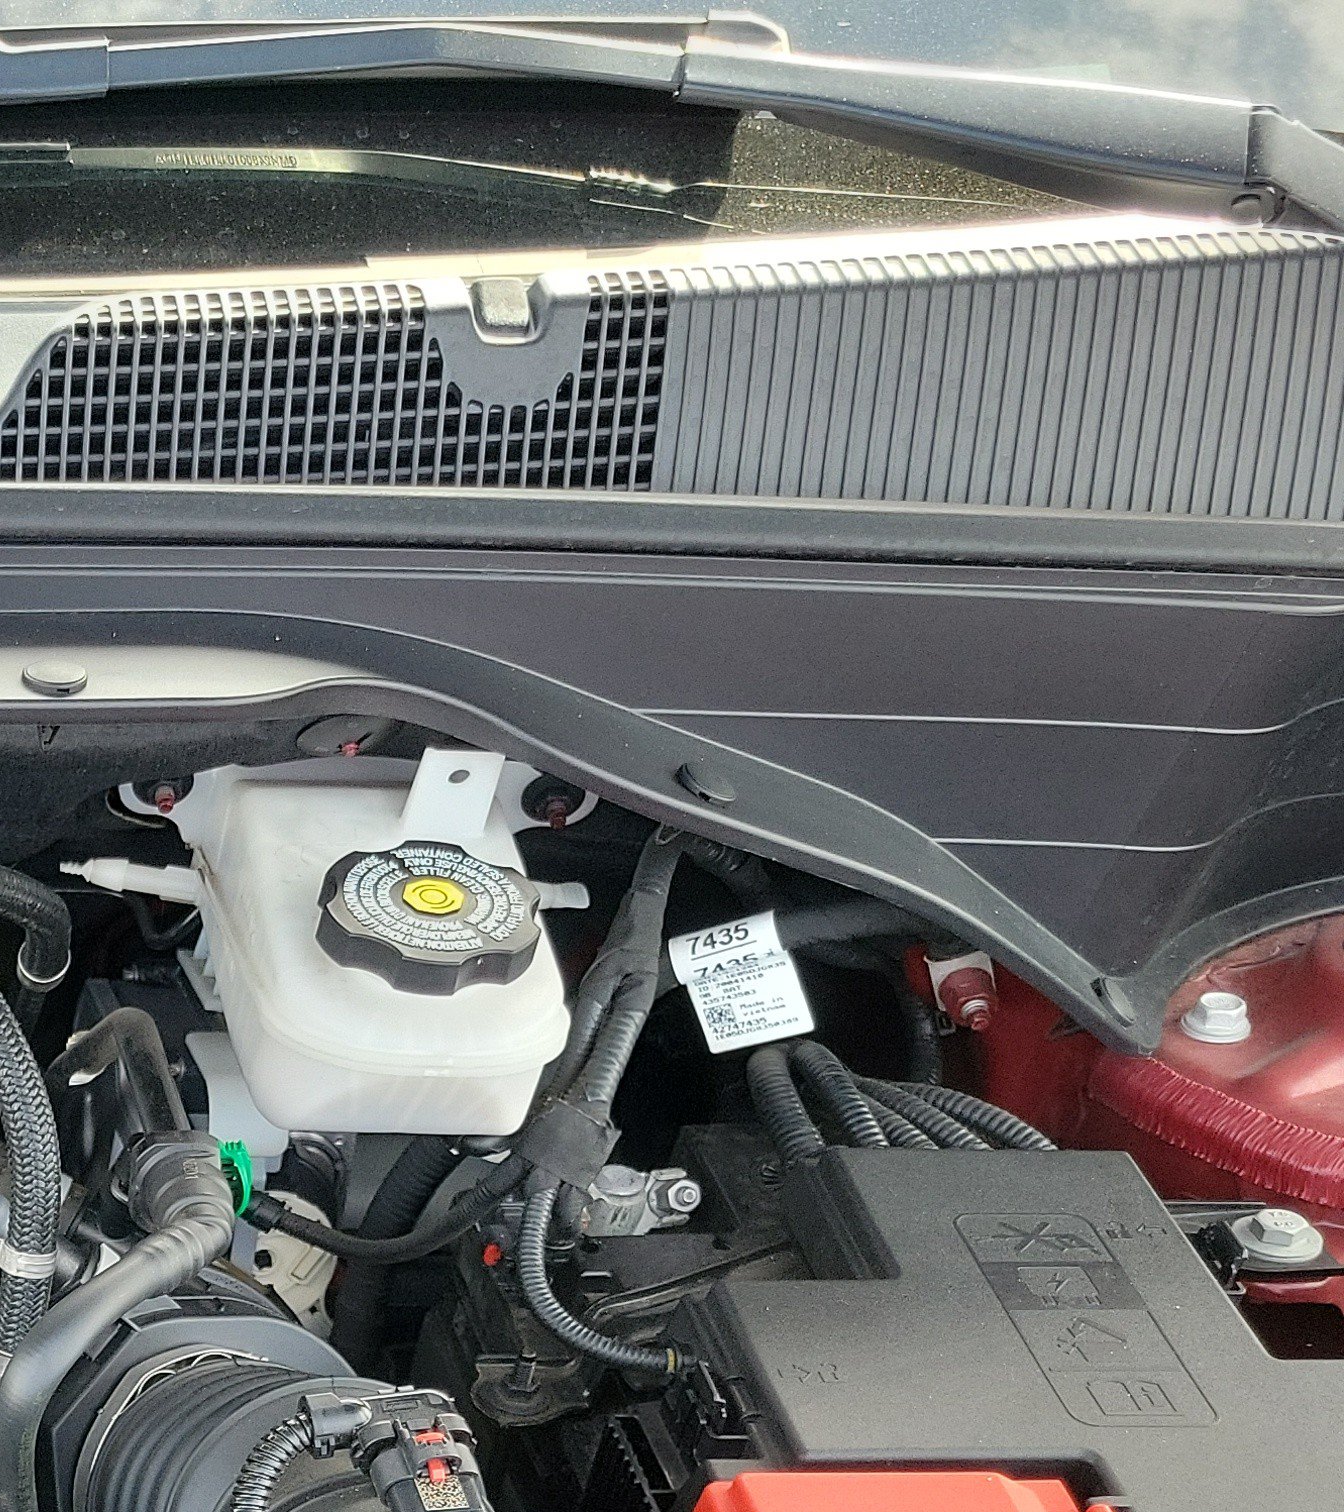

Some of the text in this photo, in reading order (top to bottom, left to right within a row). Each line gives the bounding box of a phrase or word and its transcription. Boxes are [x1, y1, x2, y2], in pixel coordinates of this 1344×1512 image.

[400, 858, 432, 867] ONLY
[460, 856, 506, 881] SEALED
[408, 867, 451, 878] FILLER
[448, 872, 485, 893] CLEAN
[686, 922, 749, 955] 7435
[739, 1000, 765, 1010] Made
